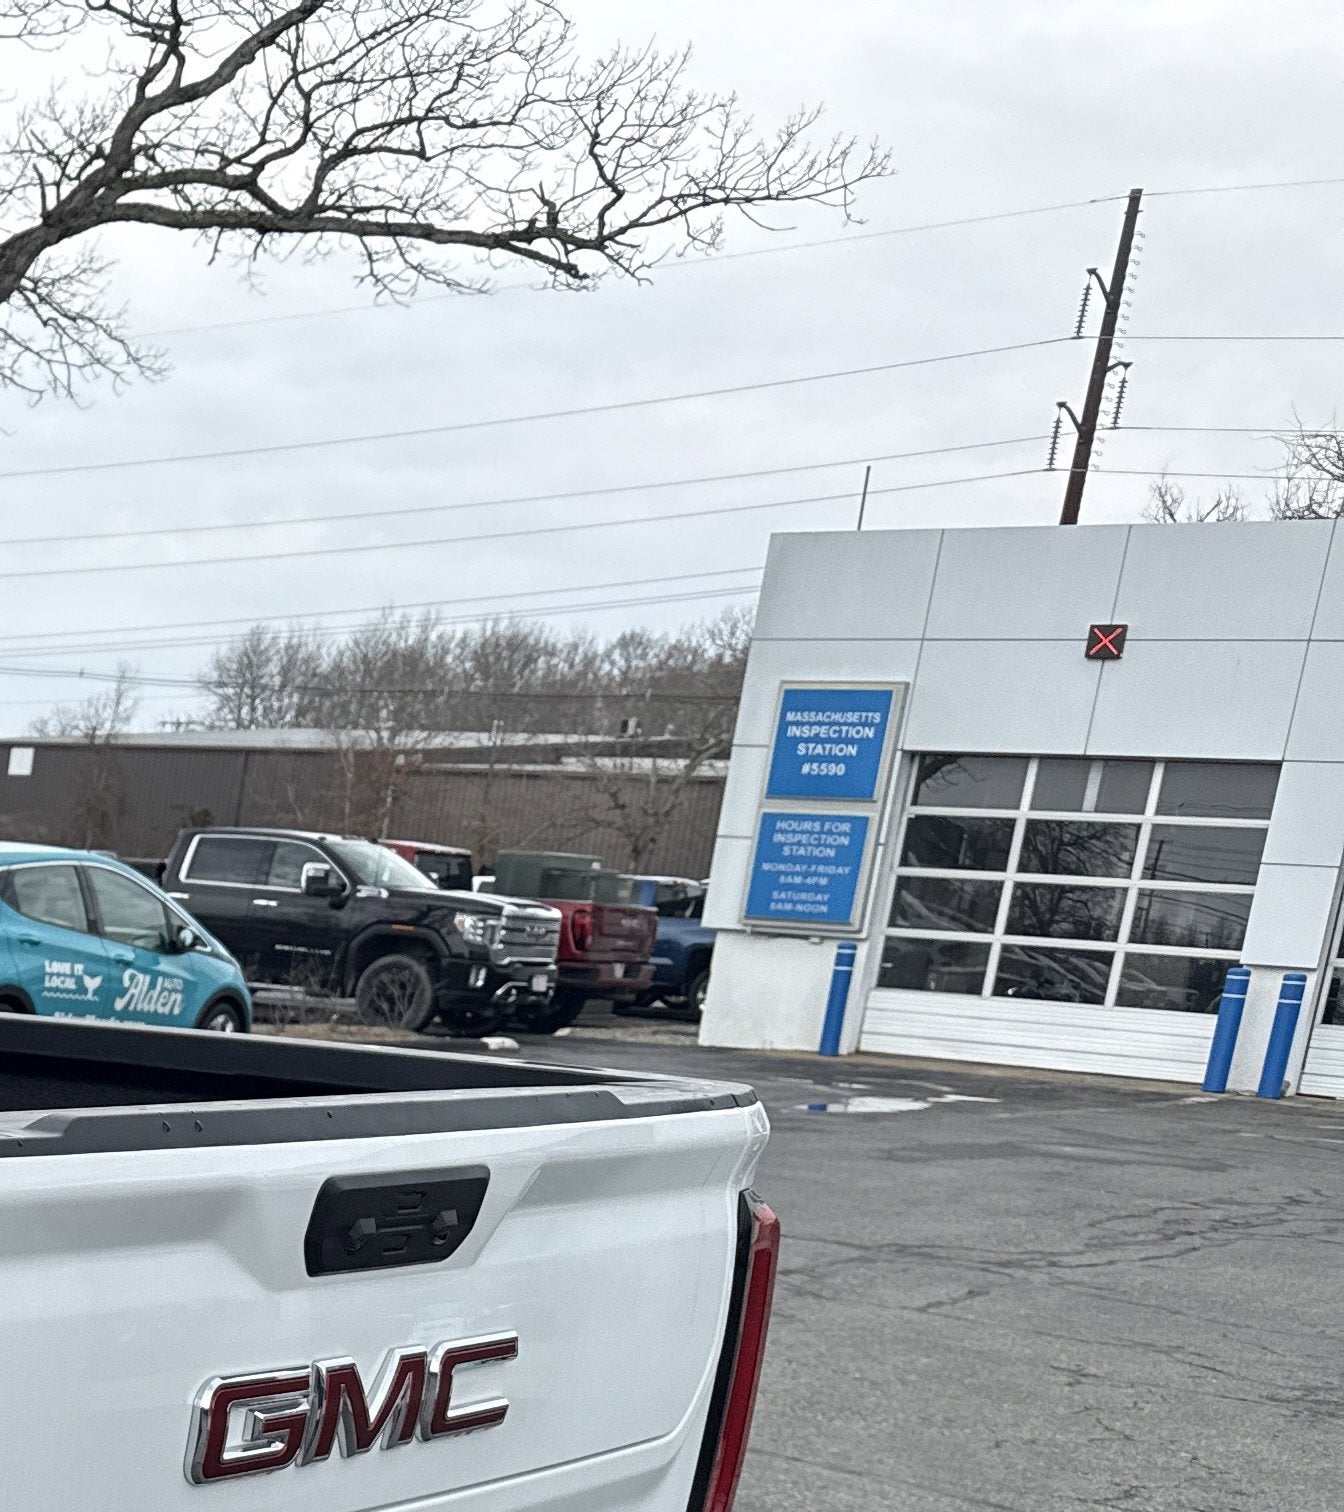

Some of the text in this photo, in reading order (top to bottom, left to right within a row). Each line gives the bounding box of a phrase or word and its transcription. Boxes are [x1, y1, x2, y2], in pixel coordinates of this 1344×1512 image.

[785, 710, 881, 724] MASSACHUSETTS
[786, 725, 875, 739] INSPECTION
[796, 743, 857, 757] STATION
[801, 762, 845, 776] #5590
[775, 819, 851, 833] HOURS FOR
[773, 833, 849, 845] INSPECTION
[782, 846, 835, 857] STATION
[772, 890, 829, 901] SATURDAY
[44, 960, 85, 975] LOVE IT
[44, 975, 77, 990] LOCAL
[163, 977, 184, 990] AUTO
[114, 968, 184, 1016] Alden
[184, 1330, 519, 1486] GMC
